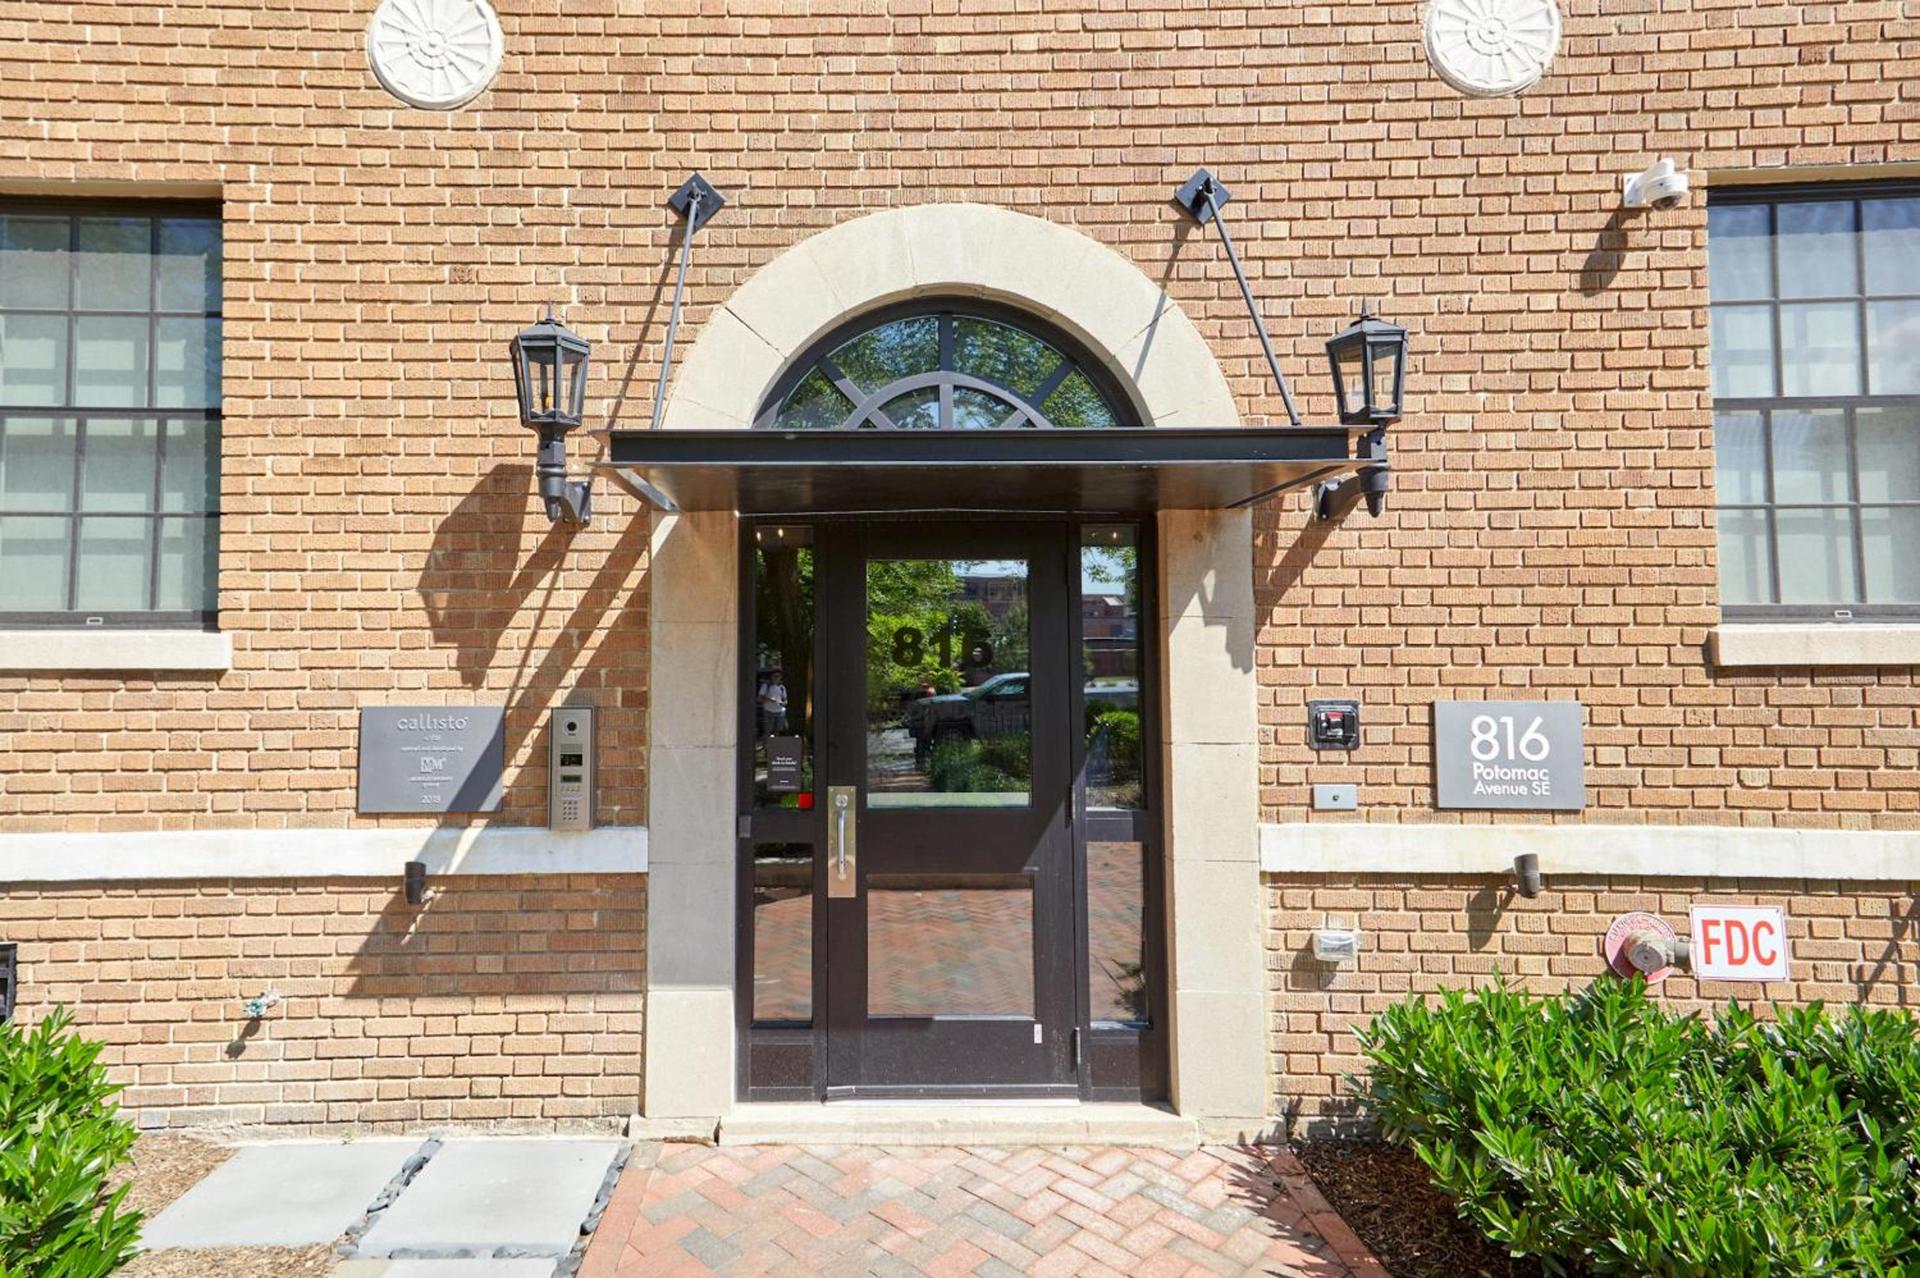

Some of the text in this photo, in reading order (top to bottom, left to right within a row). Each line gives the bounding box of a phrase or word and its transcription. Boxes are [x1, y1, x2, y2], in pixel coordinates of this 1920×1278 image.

[892, 627, 993, 667] 816
[1471, 715, 1550, 761] 816
[1472, 780, 1551, 795] Avenue SE
[1473, 762, 1550, 780] Potomac
[1701, 919, 1777, 966] FDC
